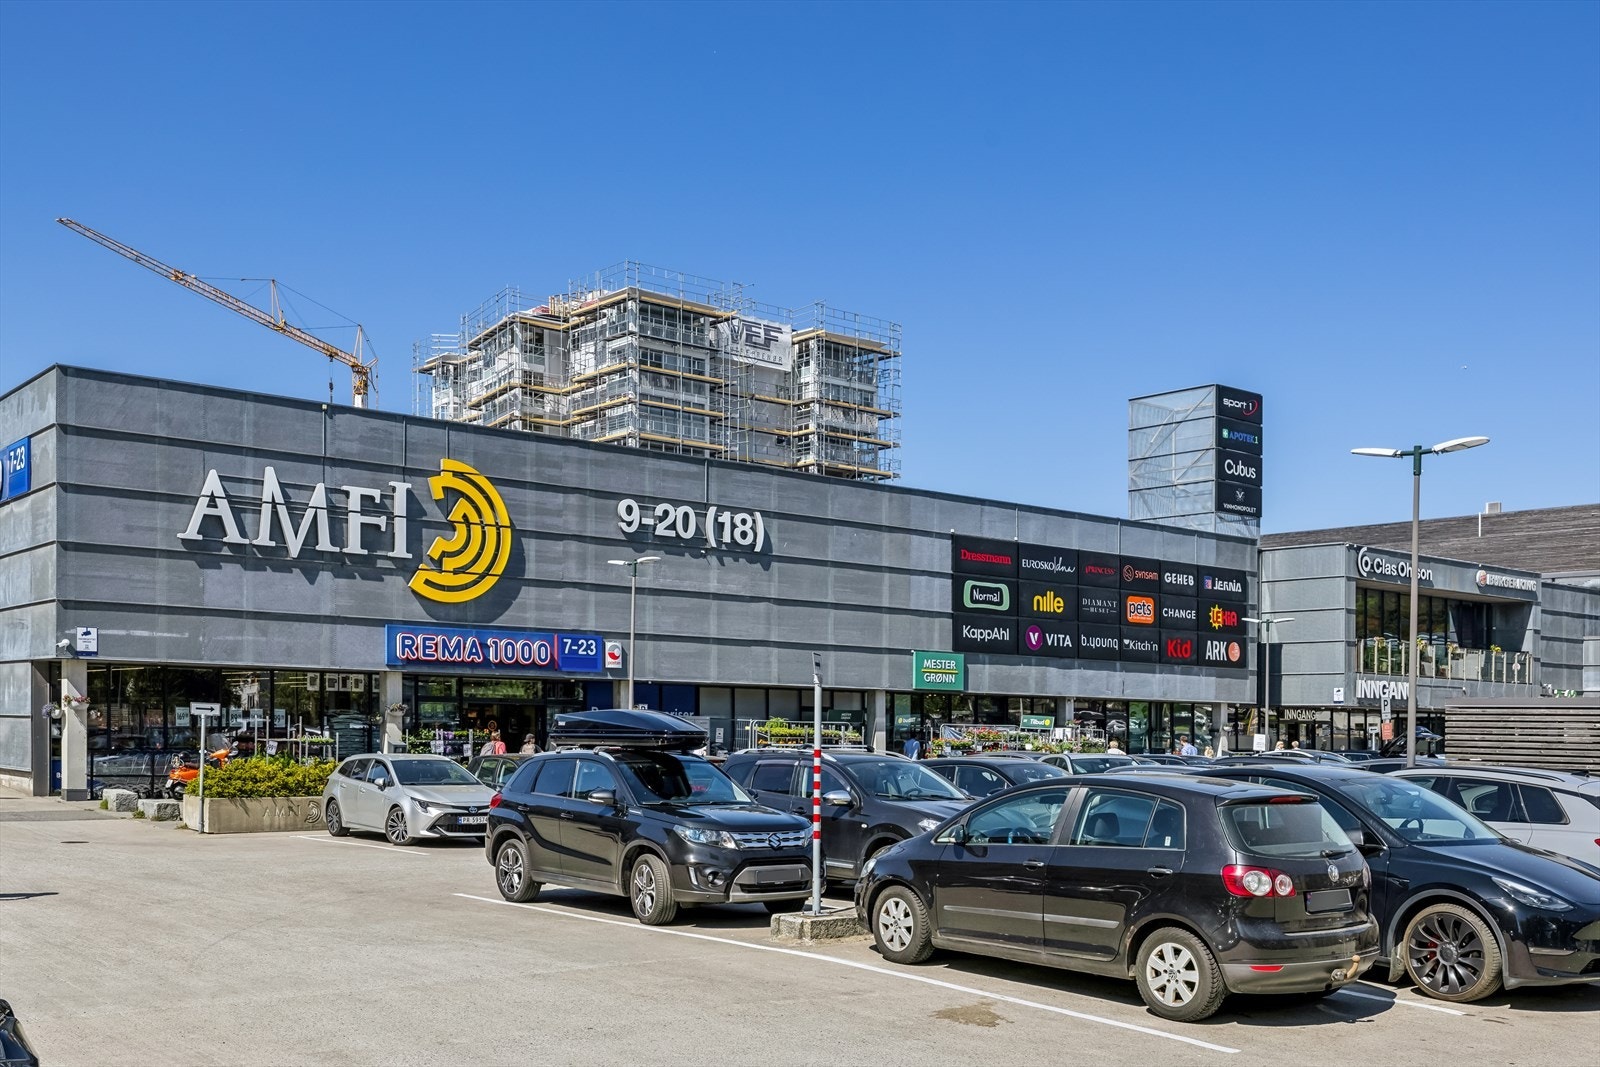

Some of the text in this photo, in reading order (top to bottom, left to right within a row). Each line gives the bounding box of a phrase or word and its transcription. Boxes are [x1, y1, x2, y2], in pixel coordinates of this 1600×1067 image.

[1223, 398, 1246, 409] sport
[1229, 430, 1254, 443] APOTEK
[9, 446, 25, 473] 7-23
[1224, 459, 1256, 478] Cubus
[177, 466, 412, 559] AMFI
[1223, 503, 1256, 513] VINMONOPOLET
[617, 499, 765, 552] 9-20 (18)
[961, 549, 1012, 565] Dressmann
[1022, 558, 1055, 571] EUROSKO
[1373, 557, 1397, 576] Clas
[1398, 562, 1433, 581] Ohson
[1486, 573, 1537, 591] BURGER KING
[973, 588, 1000, 602] Normal
[1033, 591, 1064, 613] nille
[1082, 598, 1117, 608] DIAMANT
[1128, 601, 1153, 618] pets
[1162, 607, 1196, 619] CHANGE
[962, 625, 1010, 642] KappAhl
[1046, 634, 1073, 648] VITA
[396, 632, 551, 666] REMA 1000
[563, 638, 596, 656] 7-23
[1167, 639, 1192, 658] Kid
[1205, 640, 1228, 661] ARK
[923, 659, 956, 670] MESTER
[923, 673, 956, 683] GRØNN
[1356, 679, 1410, 700] INNGAN
[1030, 718, 1045, 726] Tilbud
[1284, 709, 1317, 720] INNGANG
